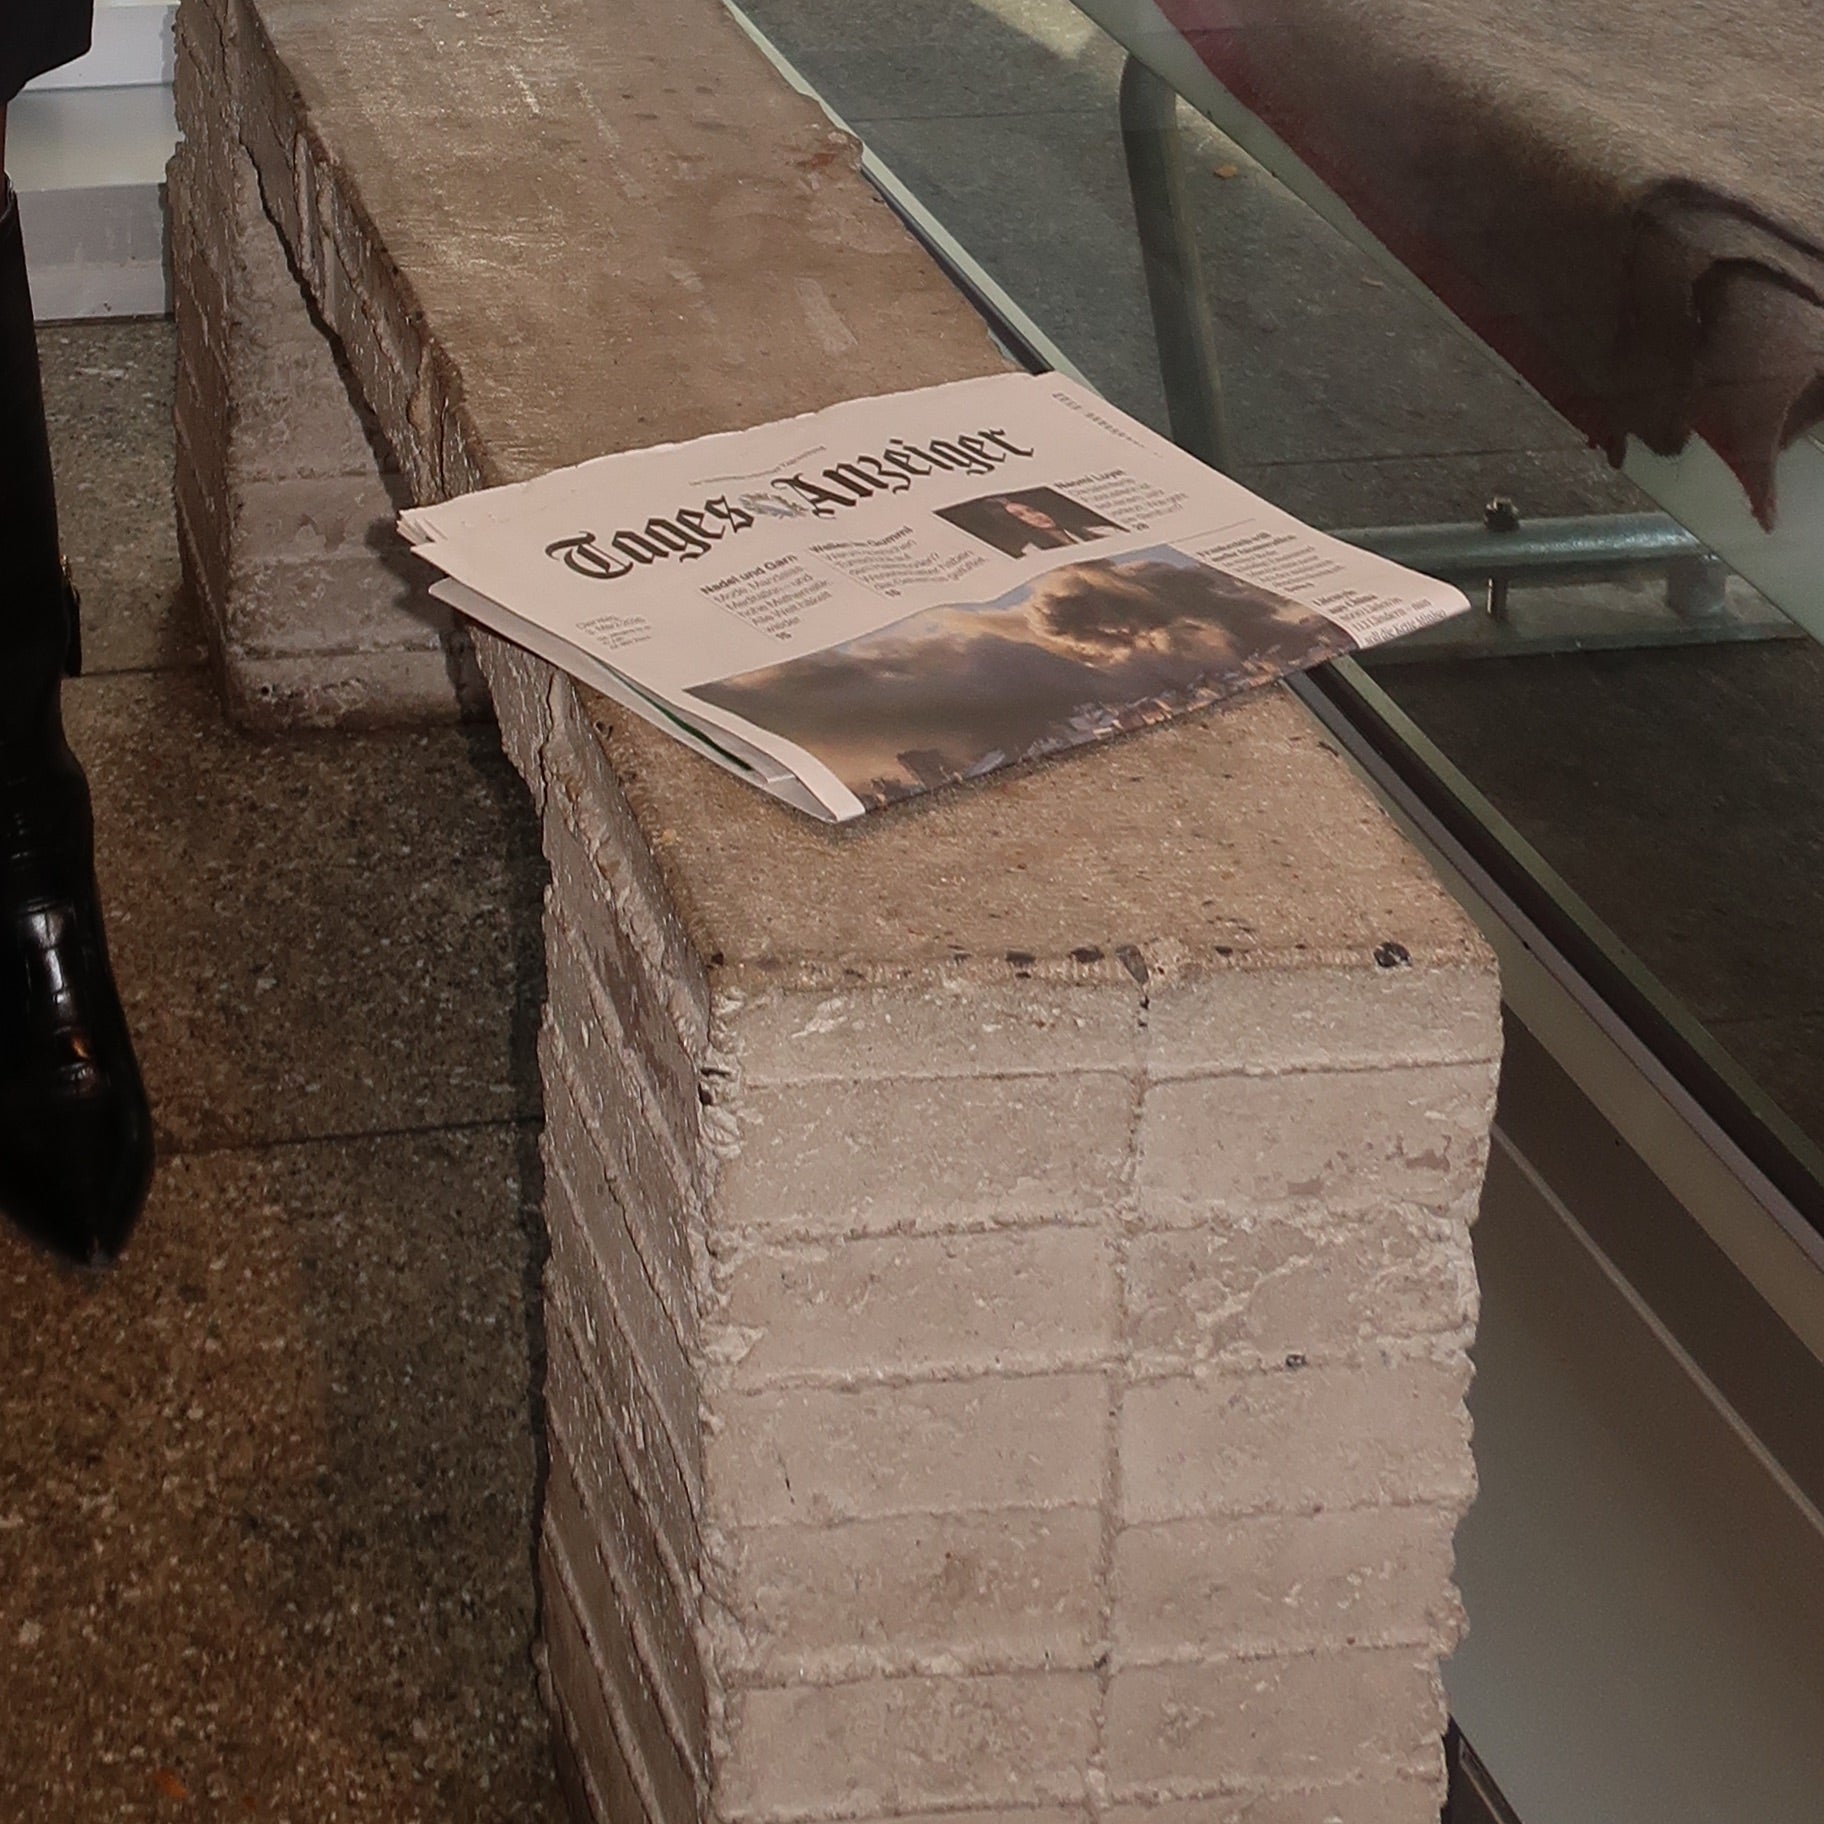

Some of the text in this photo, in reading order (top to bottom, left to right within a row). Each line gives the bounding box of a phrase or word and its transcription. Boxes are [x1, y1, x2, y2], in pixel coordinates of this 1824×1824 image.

[545, 495, 755, 580] Tages
[771, 428, 1035, 519] Anzeiger
[700, 575, 740, 594] Nadel
[739, 567, 765, 581] und
[764, 554, 798, 570] Garn
